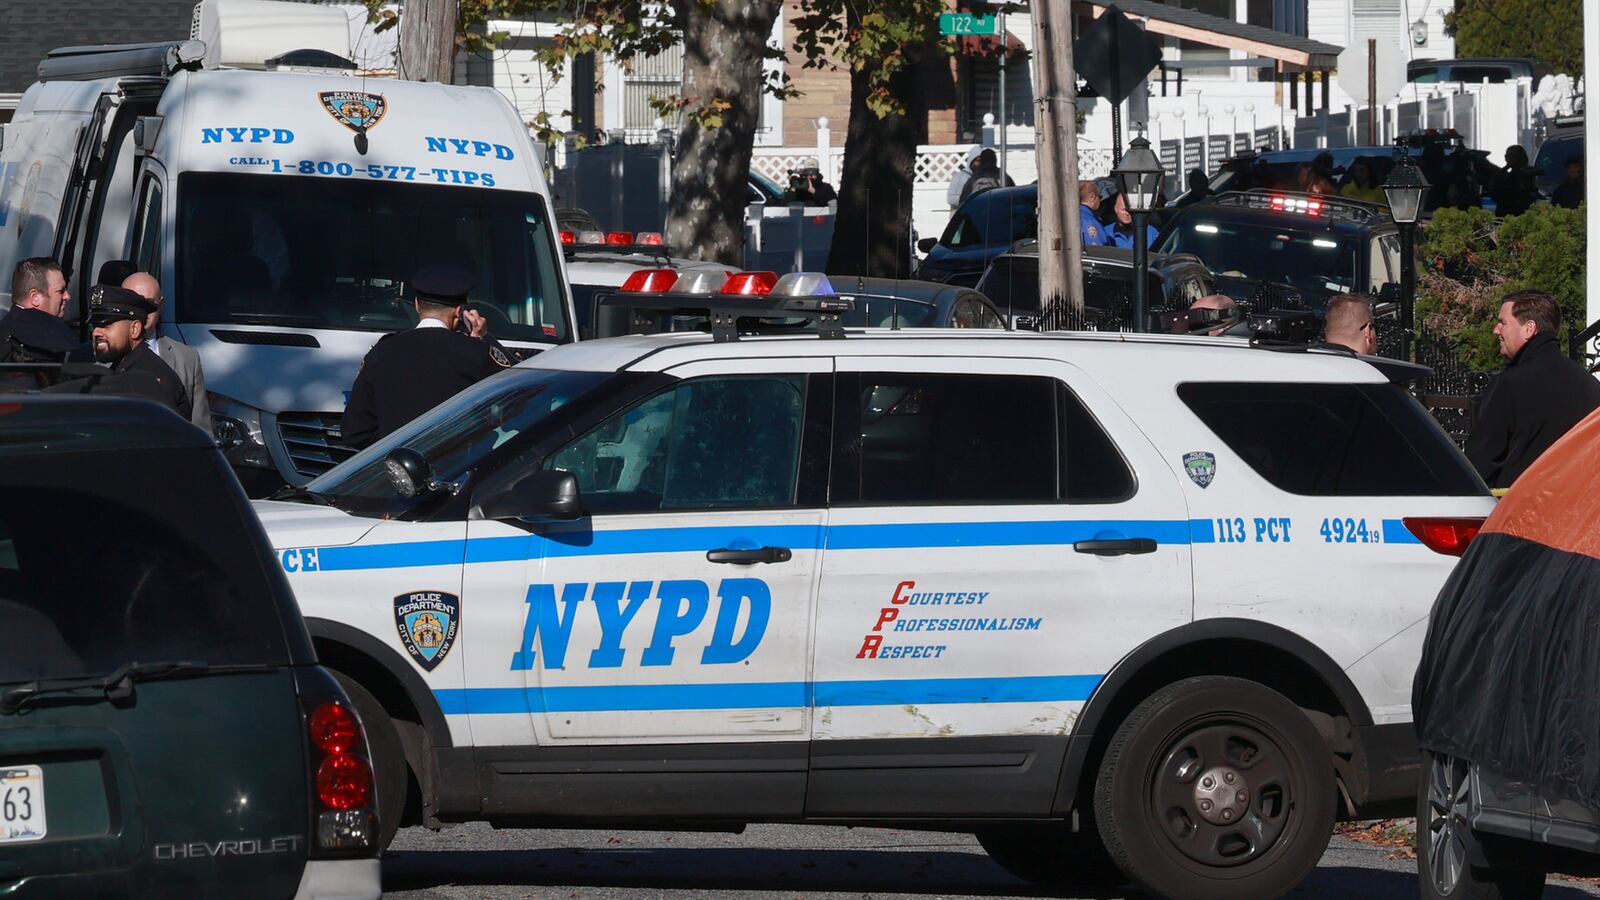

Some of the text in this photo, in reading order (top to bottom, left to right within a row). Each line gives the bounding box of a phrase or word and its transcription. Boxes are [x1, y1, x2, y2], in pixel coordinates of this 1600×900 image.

[952, 16, 971, 32] 122
[201, 127, 295, 144] NYPD
[425, 136, 515, 161] NYPD
[271, 159, 496, 187] 1-800-577-TIPS
[1216, 518, 1246, 543] 113
[1253, 518, 1292, 543] PCT
[274, 549, 317, 572] CE
[398, 602, 455, 616] DEPARTMENT
[410, 593, 441, 602] POLICE
[399, 624, 411, 643] CITY
[510, 577, 771, 671] NYPD
[408, 645, 418, 655] OF
[437, 621, 456, 658] NEW YORK
[3, 786, 32, 822] 63
[155, 834, 303, 859] CHEVROLET
